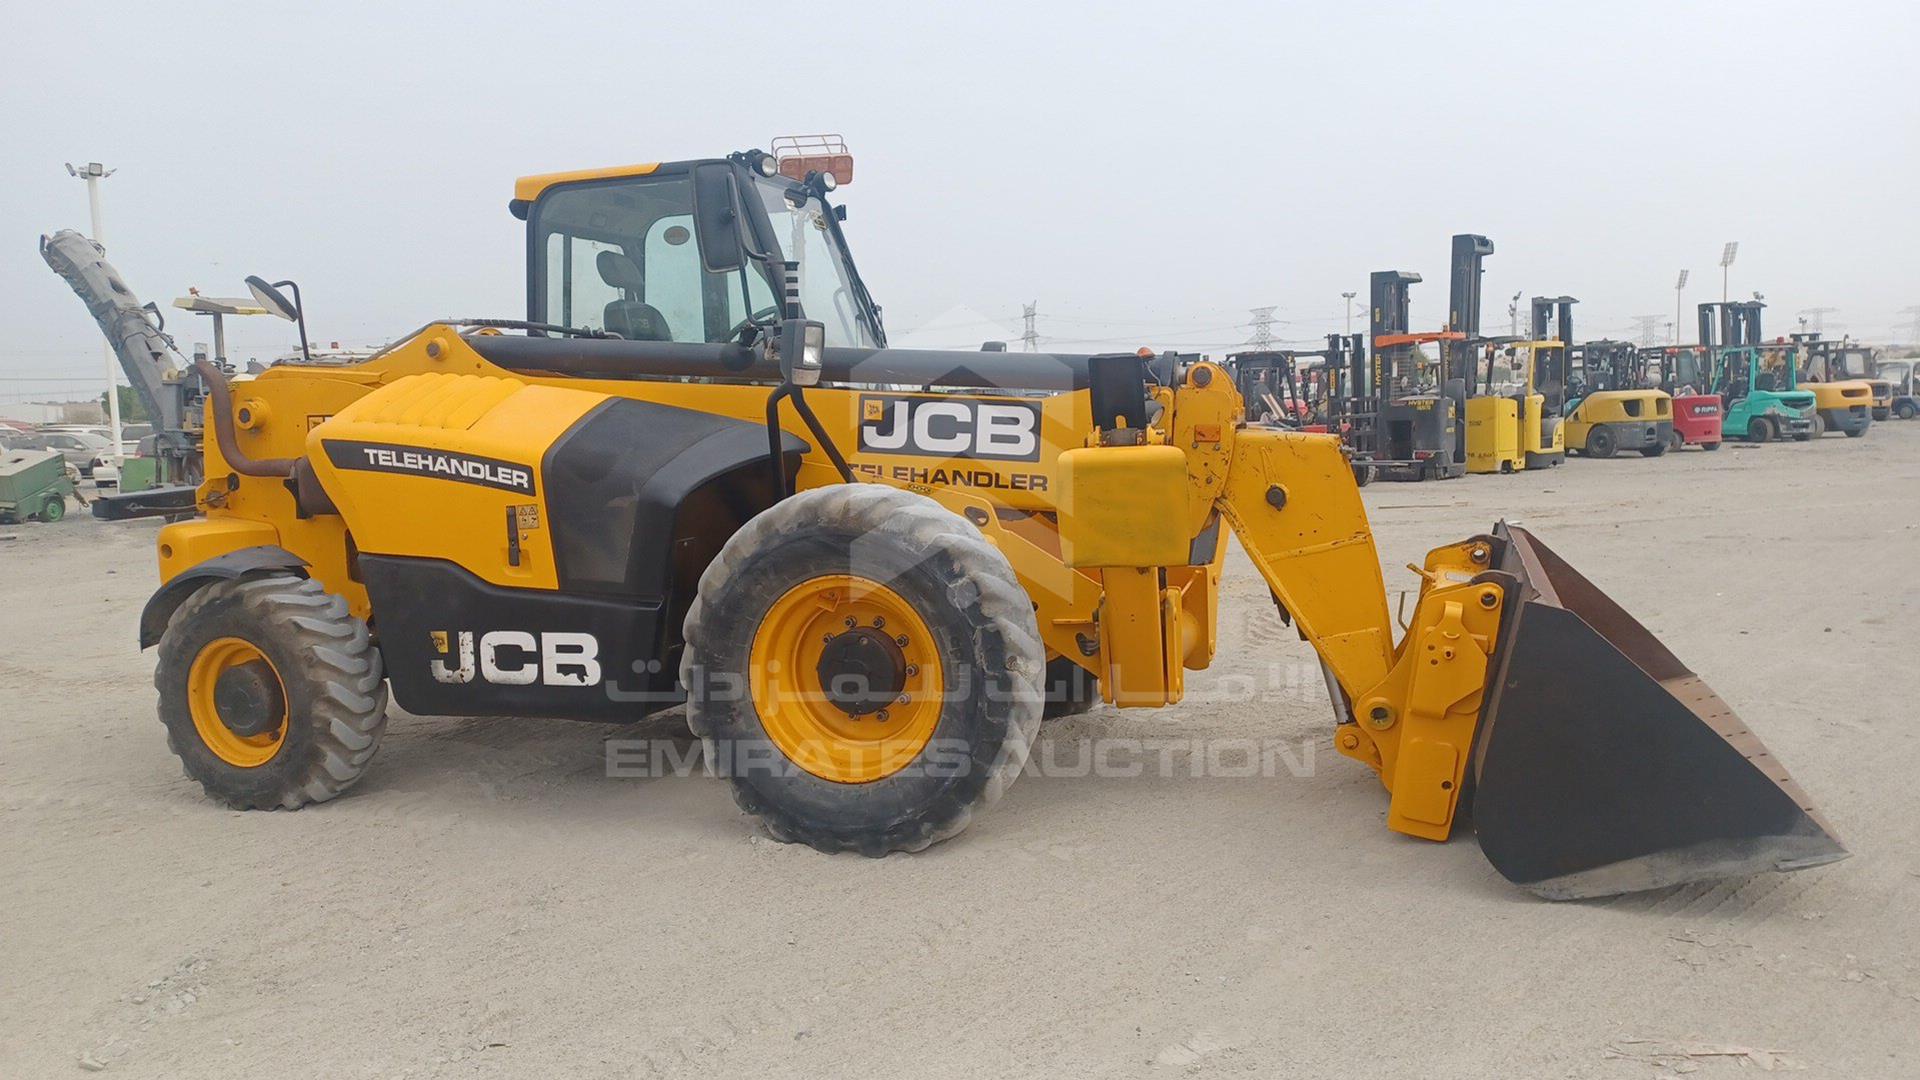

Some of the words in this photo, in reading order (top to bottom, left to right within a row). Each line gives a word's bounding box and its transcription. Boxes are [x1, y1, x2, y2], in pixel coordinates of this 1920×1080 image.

[863, 400, 1036, 456] JCB
[364, 448, 529, 488] TELEHANDLER
[431, 631, 602, 686] JCB
